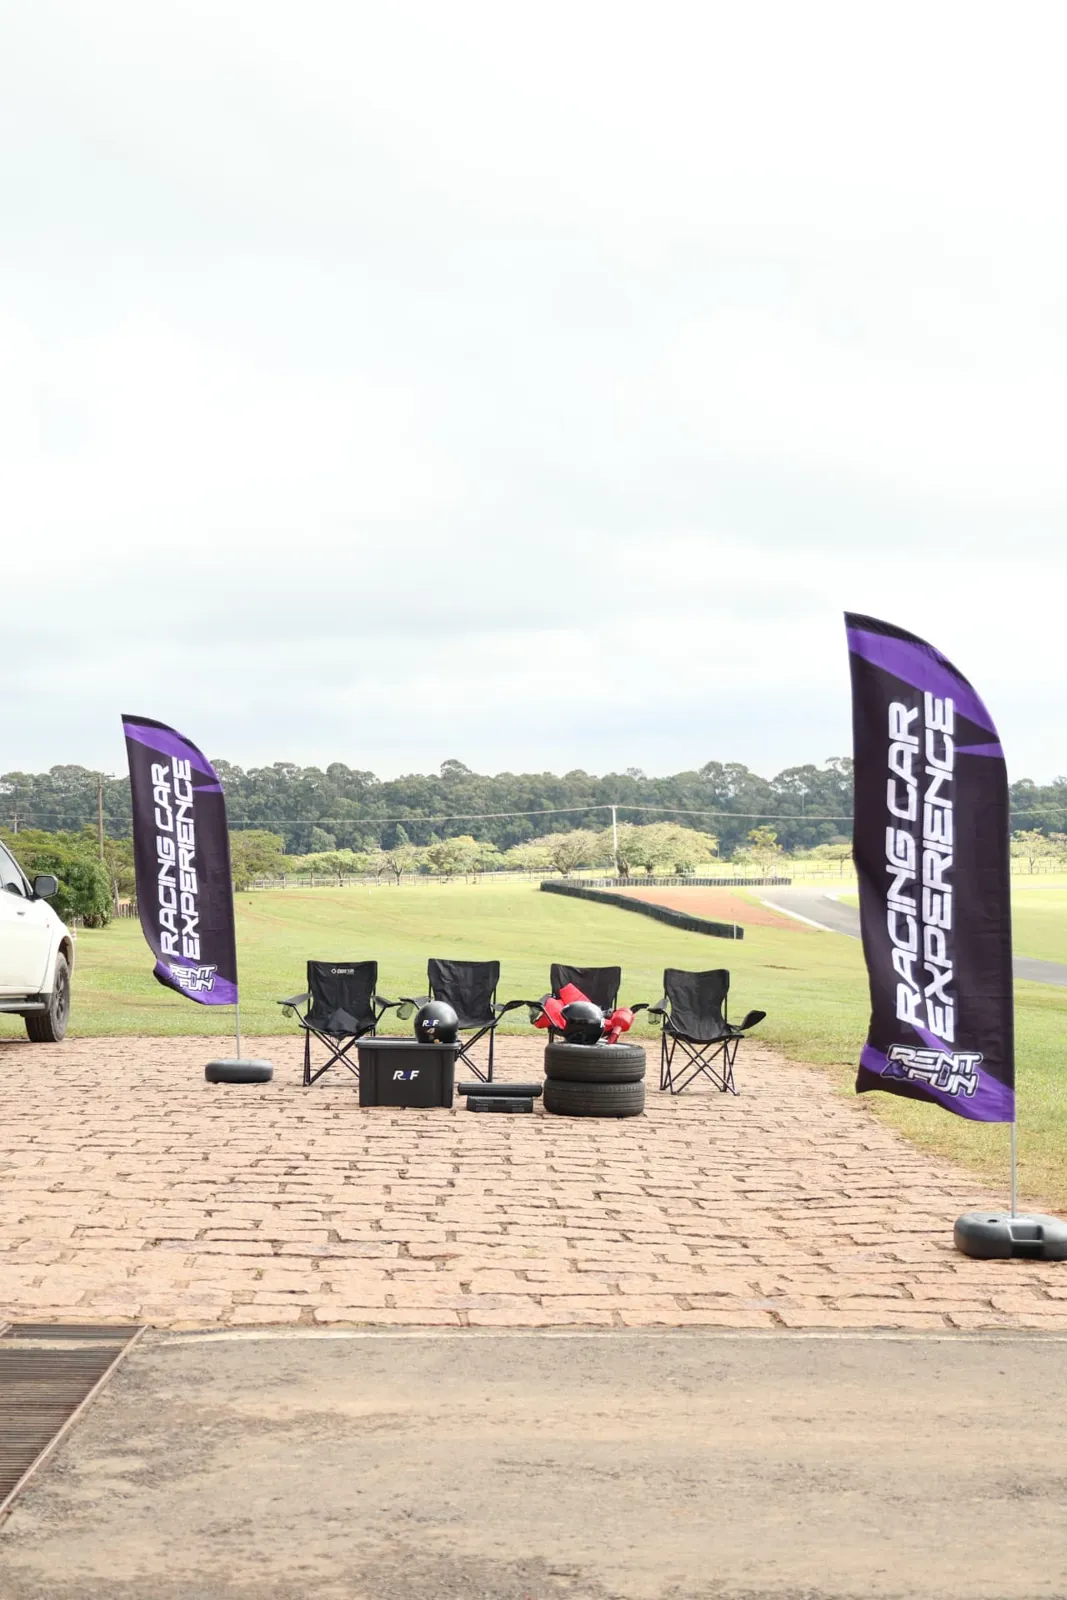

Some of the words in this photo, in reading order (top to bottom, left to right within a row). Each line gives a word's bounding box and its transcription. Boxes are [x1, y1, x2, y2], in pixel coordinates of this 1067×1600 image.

[151, 763, 173, 832] CAR
[887, 701, 919, 822] CAR
[156, 836, 180, 956] RACING
[171, 756, 200, 960] EXPERIENCE
[922, 691, 955, 1043] EXPERIENCE
[885, 826, 925, 1029] RACING
[890, 1046, 981, 1074] RENT
[907, 1068, 977, 1095] FUN
